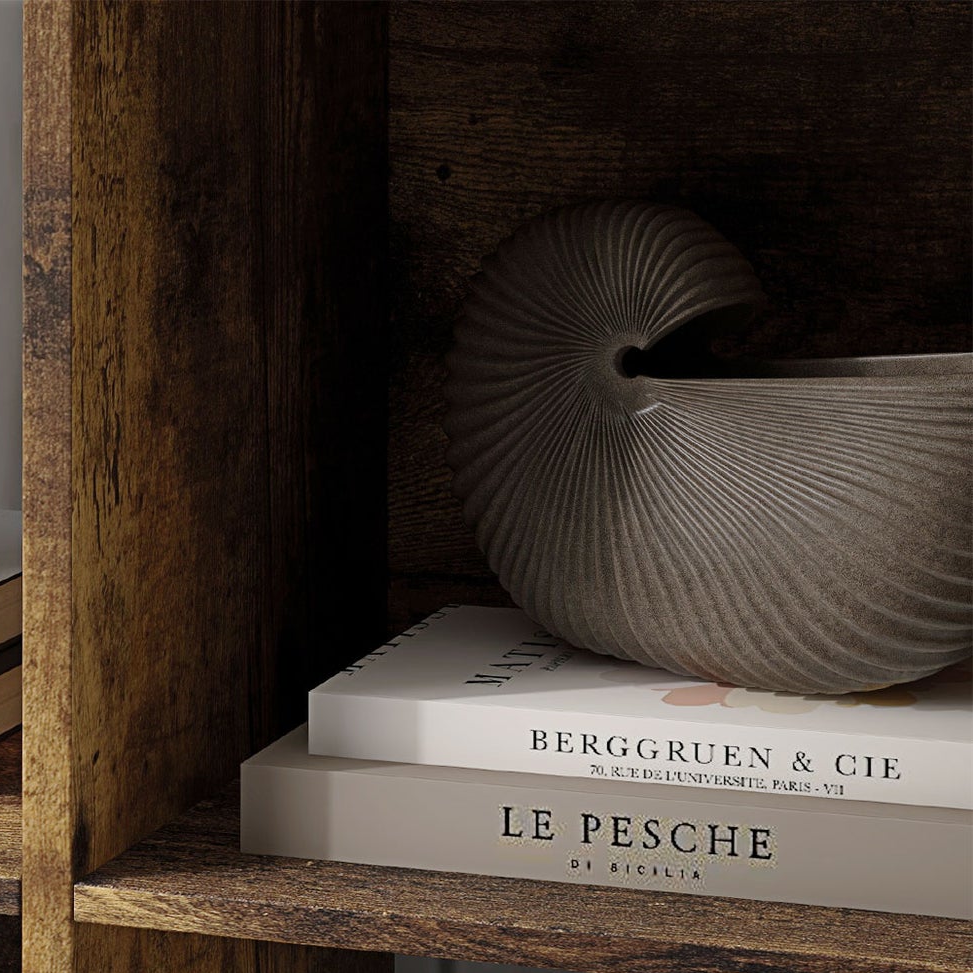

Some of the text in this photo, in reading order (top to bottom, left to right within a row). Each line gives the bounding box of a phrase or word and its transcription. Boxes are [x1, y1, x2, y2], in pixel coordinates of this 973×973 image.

[529, 729, 902, 780] BERGGRUEN & CIE
[610, 765, 640, 779] RUE
[643, 768, 663, 781] DE
[773, 779, 812, 794] PARIS
[502, 806, 773, 861] LE PESCHE
[570, 859, 701, 881] DI SICILIA
